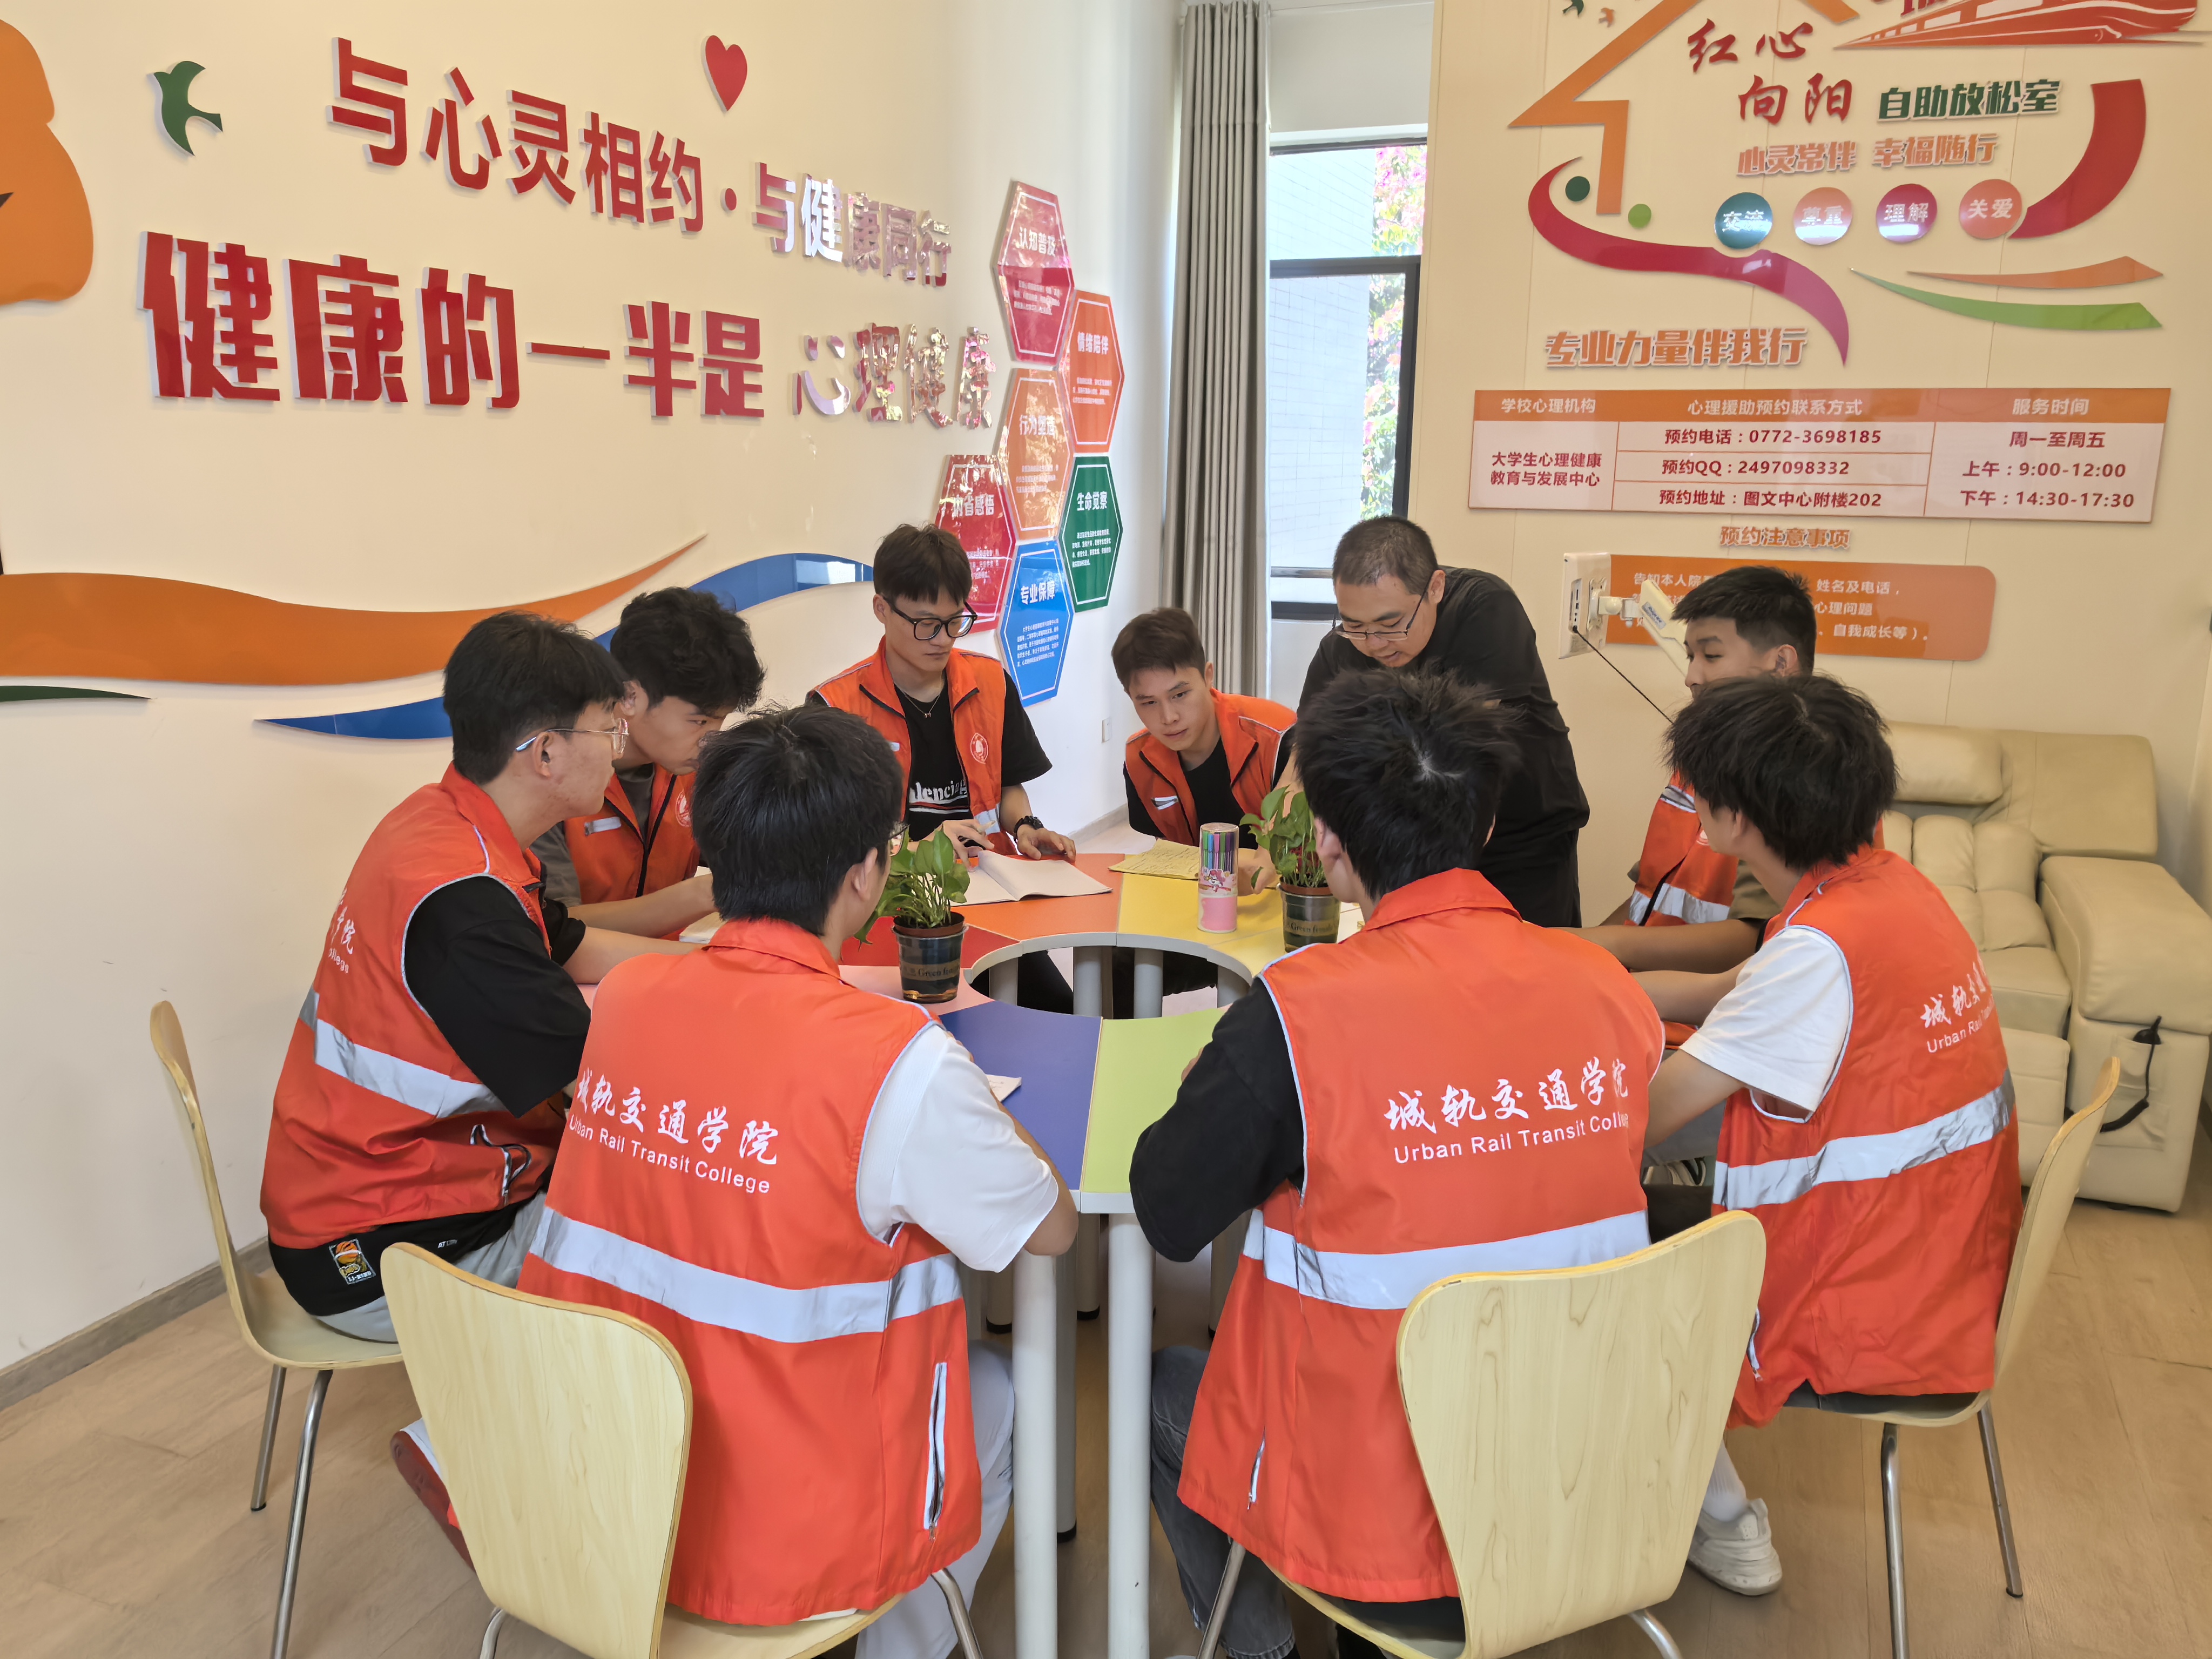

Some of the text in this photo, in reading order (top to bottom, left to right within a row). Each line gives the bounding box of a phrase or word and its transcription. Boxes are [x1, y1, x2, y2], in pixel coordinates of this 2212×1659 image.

[1688, 18, 1813, 73] 红心
[1738, 73, 1852, 125] 向阳
[1878, 79, 2060, 122] 自助放松室
[1737, 133, 1999, 177] 心灵常伴 幸福随行
[1801, 205, 1844, 226] 尊重
[1884, 203, 1930, 224] 理解
[1968, 198, 2014, 219] 关爱
[1018, 226, 1056, 257] 认知普及
[1545, 327, 1808, 367] 专业力量伴我行
[1501, 398, 1596, 414] 学校心理机构
[1687, 399, 1863, 416] 心理援助预约联系方式
[2012, 398, 2090, 415] 服务时间
[2009, 431, 2106, 448] 周一至周五
[1492, 451, 1602, 468] 大学生心理健康
[1491, 470, 1600, 487] 教育与发展中心
[1077, 491, 1108, 511] 生命觉察
[1719, 526, 1851, 549] 预约注意事项
[1020, 579, 1056, 605] 专业保障
[1815, 602, 1873, 616] 心理问题
[1926, 1029, 1966, 1053] Urban
[1384, 1056, 1629, 1134] 城轨交通学院
[577, 1067, 778, 1165] 城轨交通学院
[1394, 1143, 1462, 1164] Urban
[1472, 1132, 1512, 1154] Rail
[1518, 1119, 1587, 1148] Transit
[569, 1114, 771, 1194] Urban Rail Transit College
